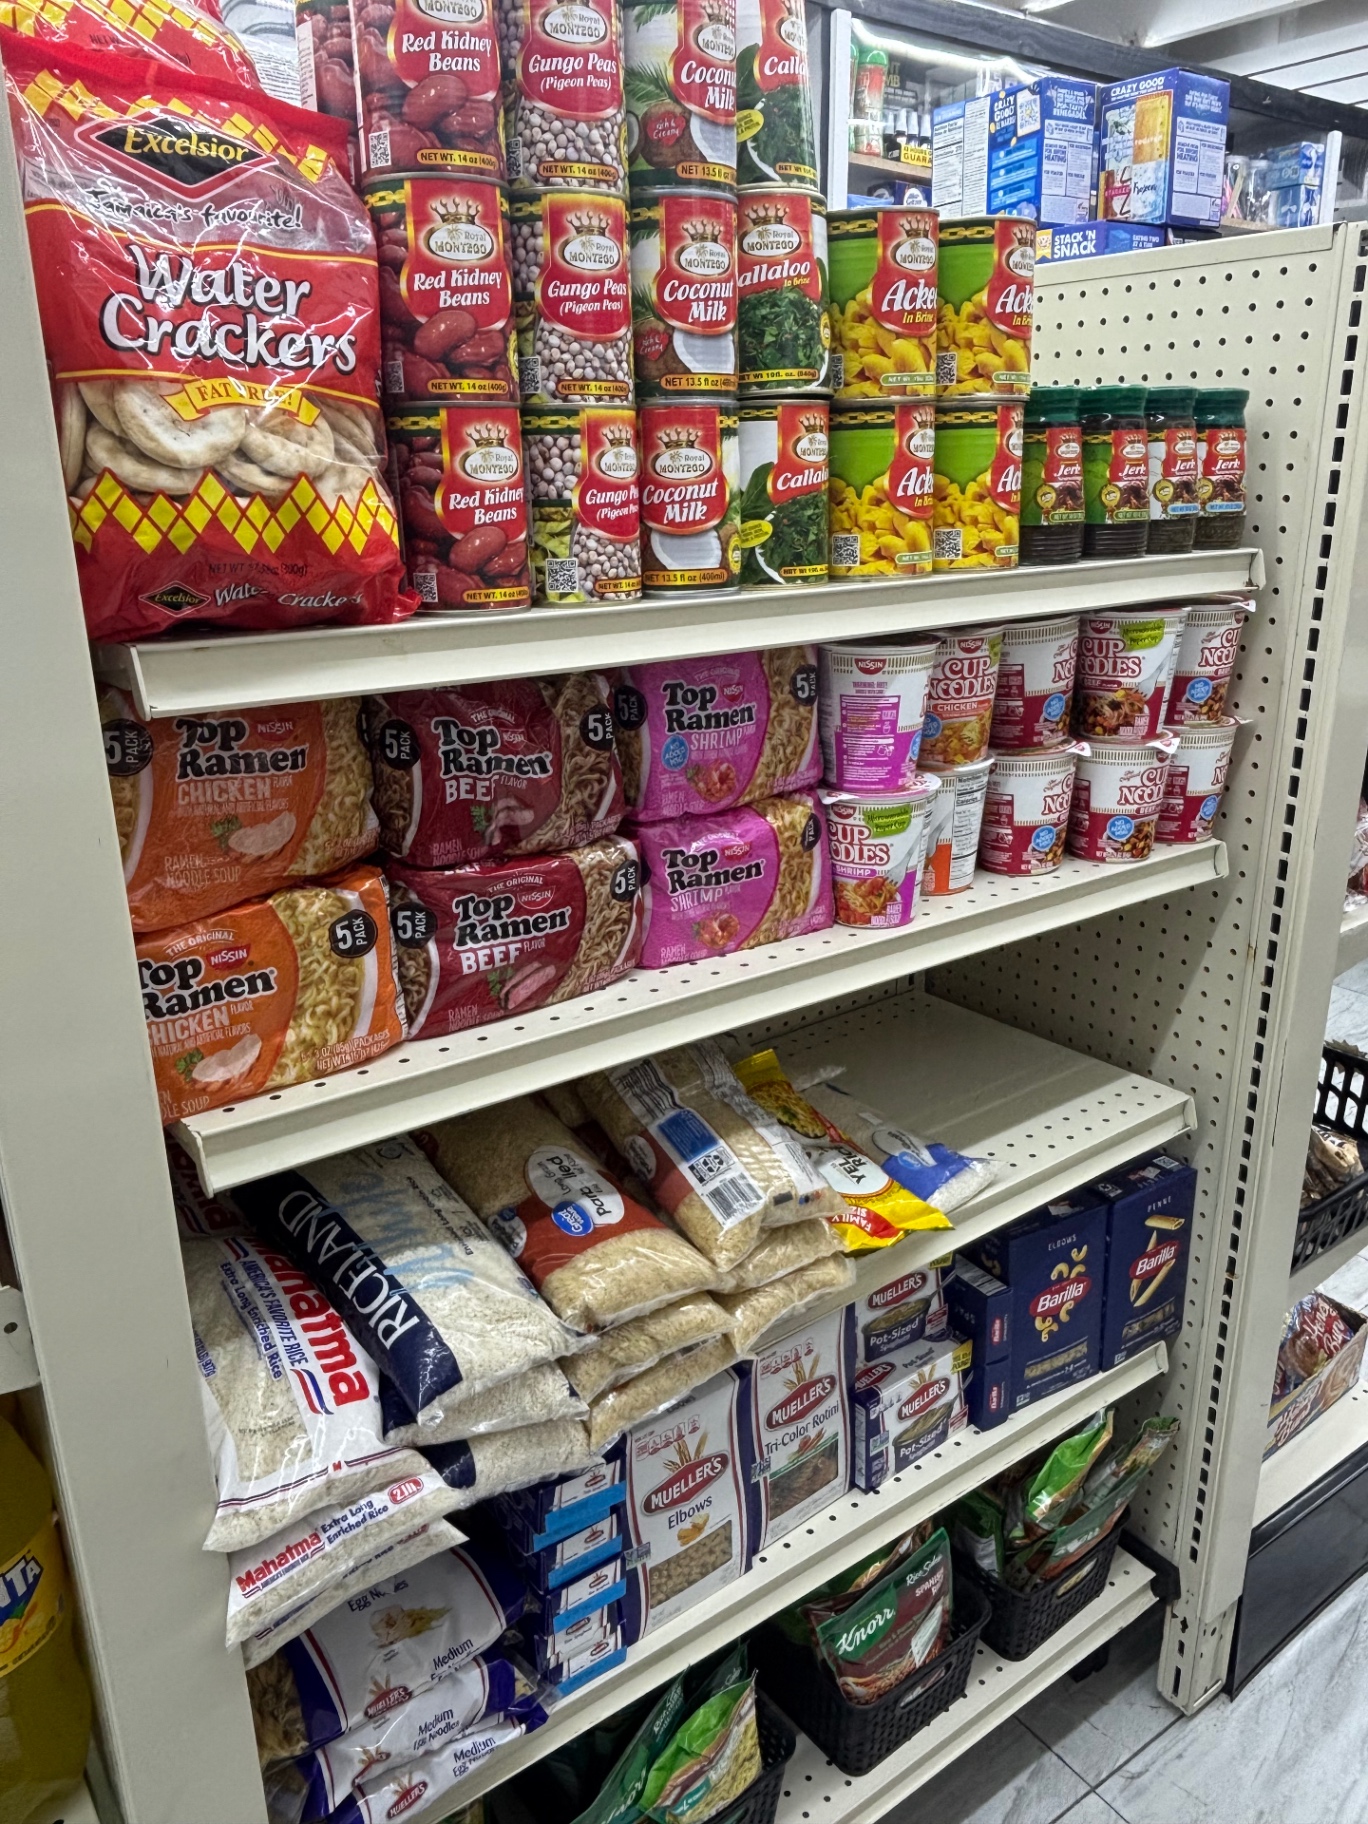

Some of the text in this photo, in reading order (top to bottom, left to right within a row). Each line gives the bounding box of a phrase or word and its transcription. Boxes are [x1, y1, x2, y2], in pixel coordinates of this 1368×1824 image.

[402, 30, 492, 57] Red Kidney
[429, 53, 481, 71] Beans
[529, 53, 617, 74] Gungo Peas
[681, 60, 736, 84] Coconu
[540, 76, 612, 92] (Pigeon Peas)
[1111, 76, 1165, 96] CRAZY GOOD
[705, 87, 735, 111] Milk
[125, 127, 250, 162] Excelsior
[420, 152, 438, 161] NET
[542, 165, 557, 173] NET
[682, 165, 698, 174] NET
[201, 203, 302, 230] favourite!
[464, 230, 487, 242] Royal
[747, 239, 794, 251] MONTEGO
[772, 230, 794, 239] Royal
[1054, 230, 1096, 245] STACK 'N
[434, 241, 487, 255] MONTEGO
[570, 251, 615, 264] MONTEGO
[1053, 241, 1096, 258] SNACK
[685, 257, 726, 270] MONTEGO
[738, 261, 811, 287] allaloo
[126, 244, 311, 316] Water
[414, 268, 502, 291] Red Kidney
[548, 278, 627, 300] Gungo Peas
[663, 279, 734, 301] Coconut
[439, 290, 490, 308] Beans
[560, 298, 623, 315] (Pigeon Peas)
[688, 301, 728, 323] Milk
[903, 311, 934, 324] In Brine
[101, 293, 358, 374] Crackers
[198, 383, 234, 402] FAT
[431, 382, 448, 391] NET
[561, 384, 576, 392] NET
[665, 377, 702, 387] NET 13.5
[470, 462, 514, 475] MONTEGO
[659, 463, 705, 473] MONTEGO
[684, 454, 705, 462] Royal
[1171, 459, 1196, 471] Jerk
[1211, 458, 1240, 470] Jerk
[1054, 464, 1080, 477] Jerk
[1119, 464, 1147, 477] Jerk
[450, 491, 480, 510] Red
[586, 490, 628, 506] Gungo
[643, 478, 719, 506] Coconut
[474, 507, 517, 526] Beans
[597, 507, 629, 523] (Pigeon
[664, 501, 708, 524] Milk
[662, 574, 677, 582] 13.5
[466, 591, 483, 599] NET
[960, 640, 981, 649] NISSIN
[1081, 638, 1125, 658] CUP
[858, 660, 883, 669] NISSIN
[944, 658, 991, 679] CUP
[661, 680, 717, 712] Top
[797, 674, 809, 698] 5
[927, 673, 996, 699] NOODLES
[618, 694, 629, 720] 5
[664, 703, 757, 734] Ramen
[938, 703, 978, 711] CHICKEN
[174, 717, 249, 751] Top
[257, 721, 293, 734] NISSIN
[432, 717, 500, 754] Top
[589, 712, 614, 741] 5 PACK
[385, 730, 410, 759] 5 PACK
[691, 729, 742, 751] SHRIMP
[175, 743, 309, 782] Ramen
[439, 748, 552, 778] Ramen
[178, 778, 271, 805] CHICKEN
[445, 775, 528, 805] BEEF FLAVOR
[661, 848, 719, 872] Top
[725, 845, 750, 856] NISSIN
[506, 875, 544, 887] ORIGINAL
[614, 867, 636, 894] 5 PACK
[666, 859, 766, 895] Ramen
[836, 866, 871, 875] SHRIMP
[520, 889, 551, 903] NISSIN
[670, 887, 723, 913] SHRIMP
[453, 893, 515, 925] Top
[336, 916, 368, 950] 5 PACK
[397, 911, 426, 939] 5 PACK
[453, 906, 571, 950] Ramen
[210, 949, 248, 966] NISSIN
[459, 938, 546, 975] BEEF FLAVOR
[151, 1005, 230, 1044] HICKEN
[559, 1209, 582, 1232] Great
[831, 1213, 871, 1231] FAMILY
[1048, 1234, 1077, 1251] ELBOWS
[278, 1190, 421, 1350] RICELAND
[1135, 1245, 1177, 1277] Barilla
[872, 1274, 923, 1306] MUELLER'S
[1037, 1283, 1087, 1313] Barilla
[220, 1262, 282, 1379] Extra Long Enriched Rice
[241, 1260, 308, 1366] AMERICA'S FAVORITE RICE
[870, 1319, 920, 1346] Pot-Sized
[1323, 1319, 1345, 1354] Bun
[771, 1379, 831, 1425] MUELLER'S
[902, 1380, 946, 1418] MUELLER'S
[765, 1400, 840, 1455] Tri-Color Rotini
[900, 1425, 943, 1457] Pot-Sized
[651, 1457, 722, 1509] MUELLER'S
[321, 1500, 374, 1534] Extra Long
[668, 1496, 713, 1530] Elbows
[326, 1513, 368, 1545] Enriched
[236, 1531, 322, 1593] Mahatma
[906, 1574, 923, 1586] Rice
[348, 1597, 372, 1613] Egg
[835, 1608, 895, 1655] Knorr
[433, 1638, 474, 1671] Medium
[367, 1687, 409, 1717] MUELLER'S
[419, 1708, 454, 1736] Medium
[454, 1737, 496, 1763] Medium
[388, 1782, 427, 1817] MUELLER'S
